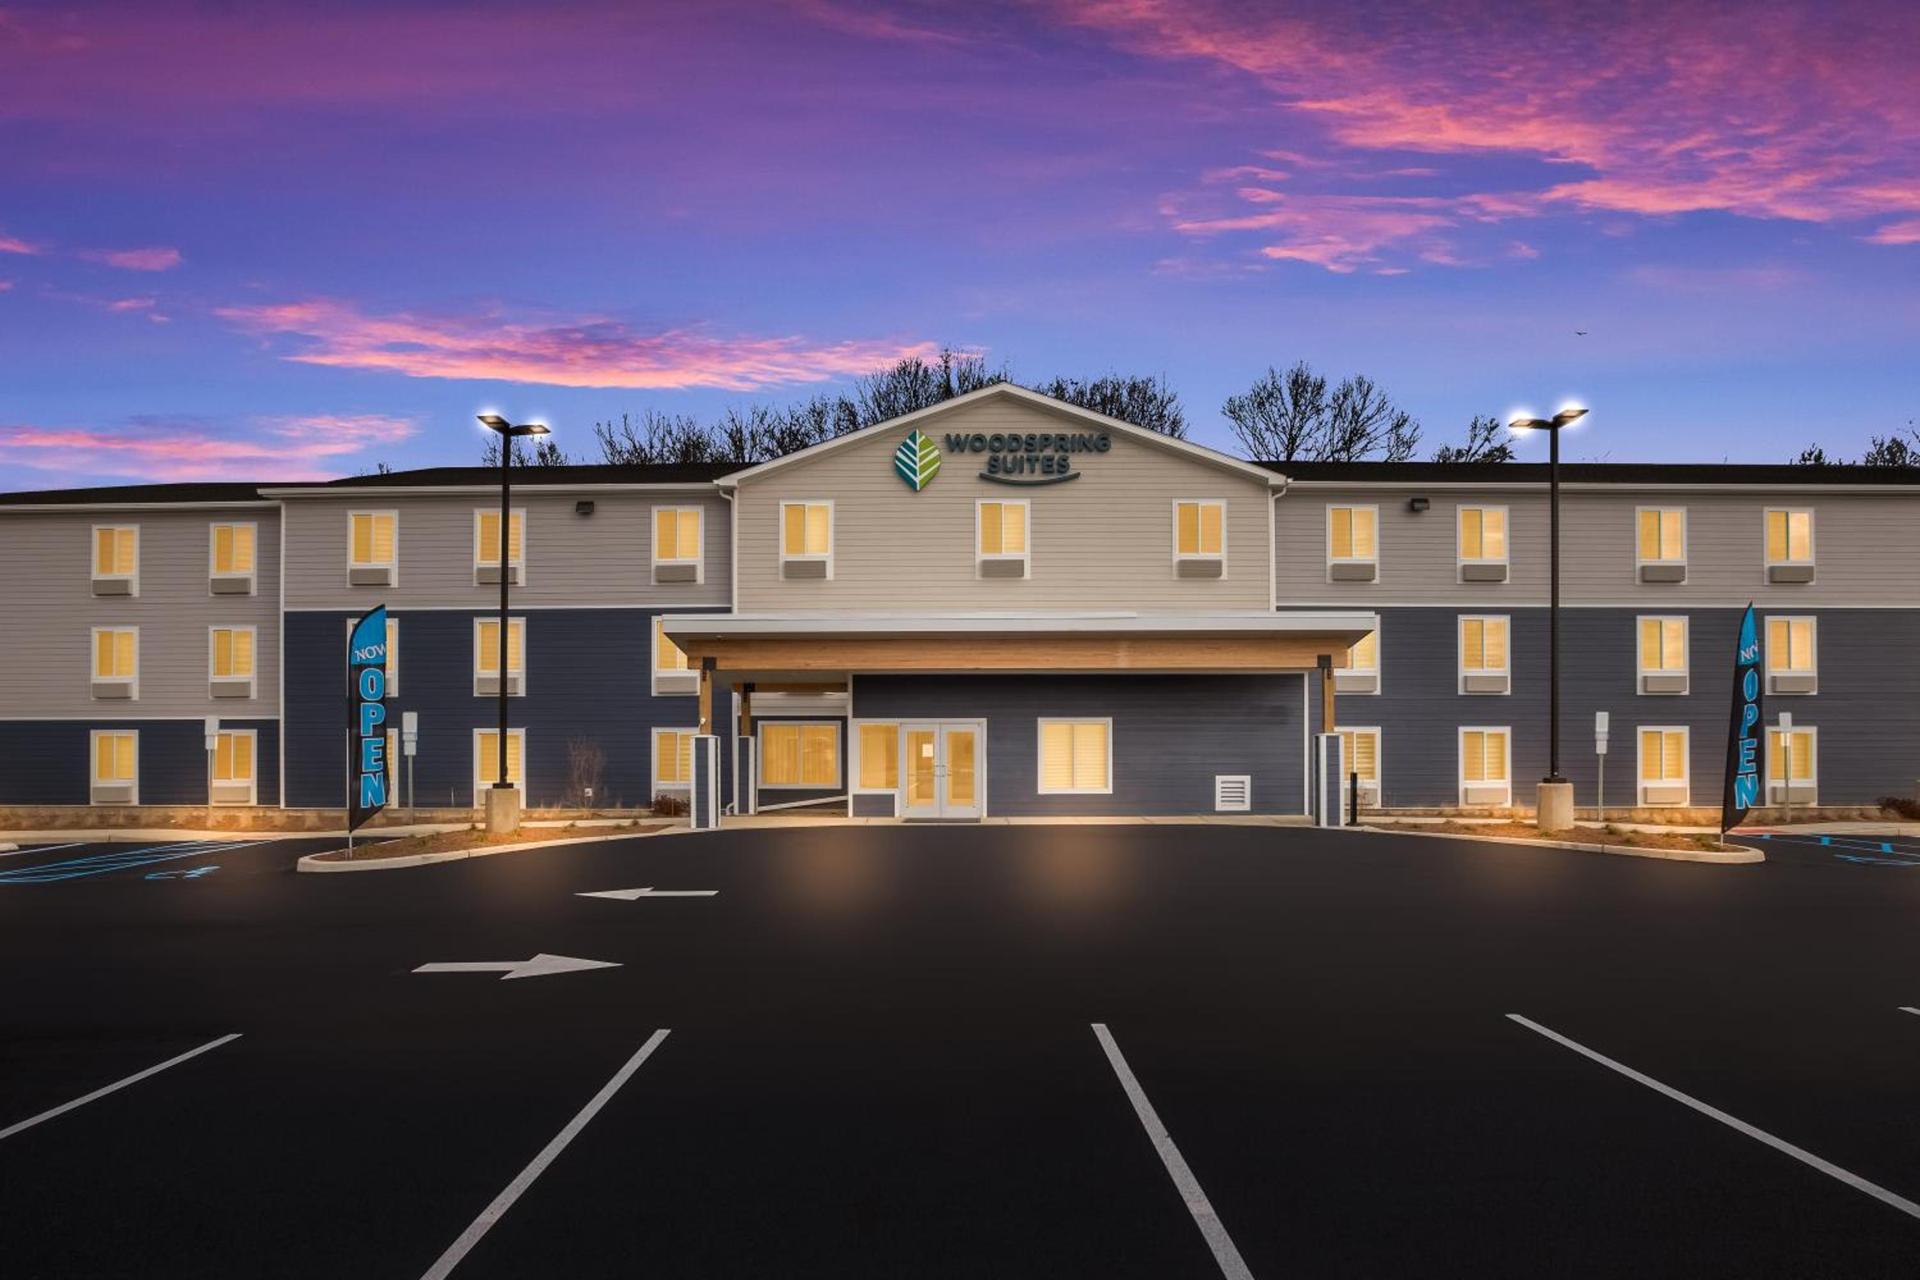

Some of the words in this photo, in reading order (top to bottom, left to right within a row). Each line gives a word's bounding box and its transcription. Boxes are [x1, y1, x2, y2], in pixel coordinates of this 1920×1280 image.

[945, 433, 1112, 453] WOODSPRING
[987, 454, 1071, 474] SUITES
[359, 667, 386, 808] OPEN
[1734, 668, 1759, 810] OPEN
